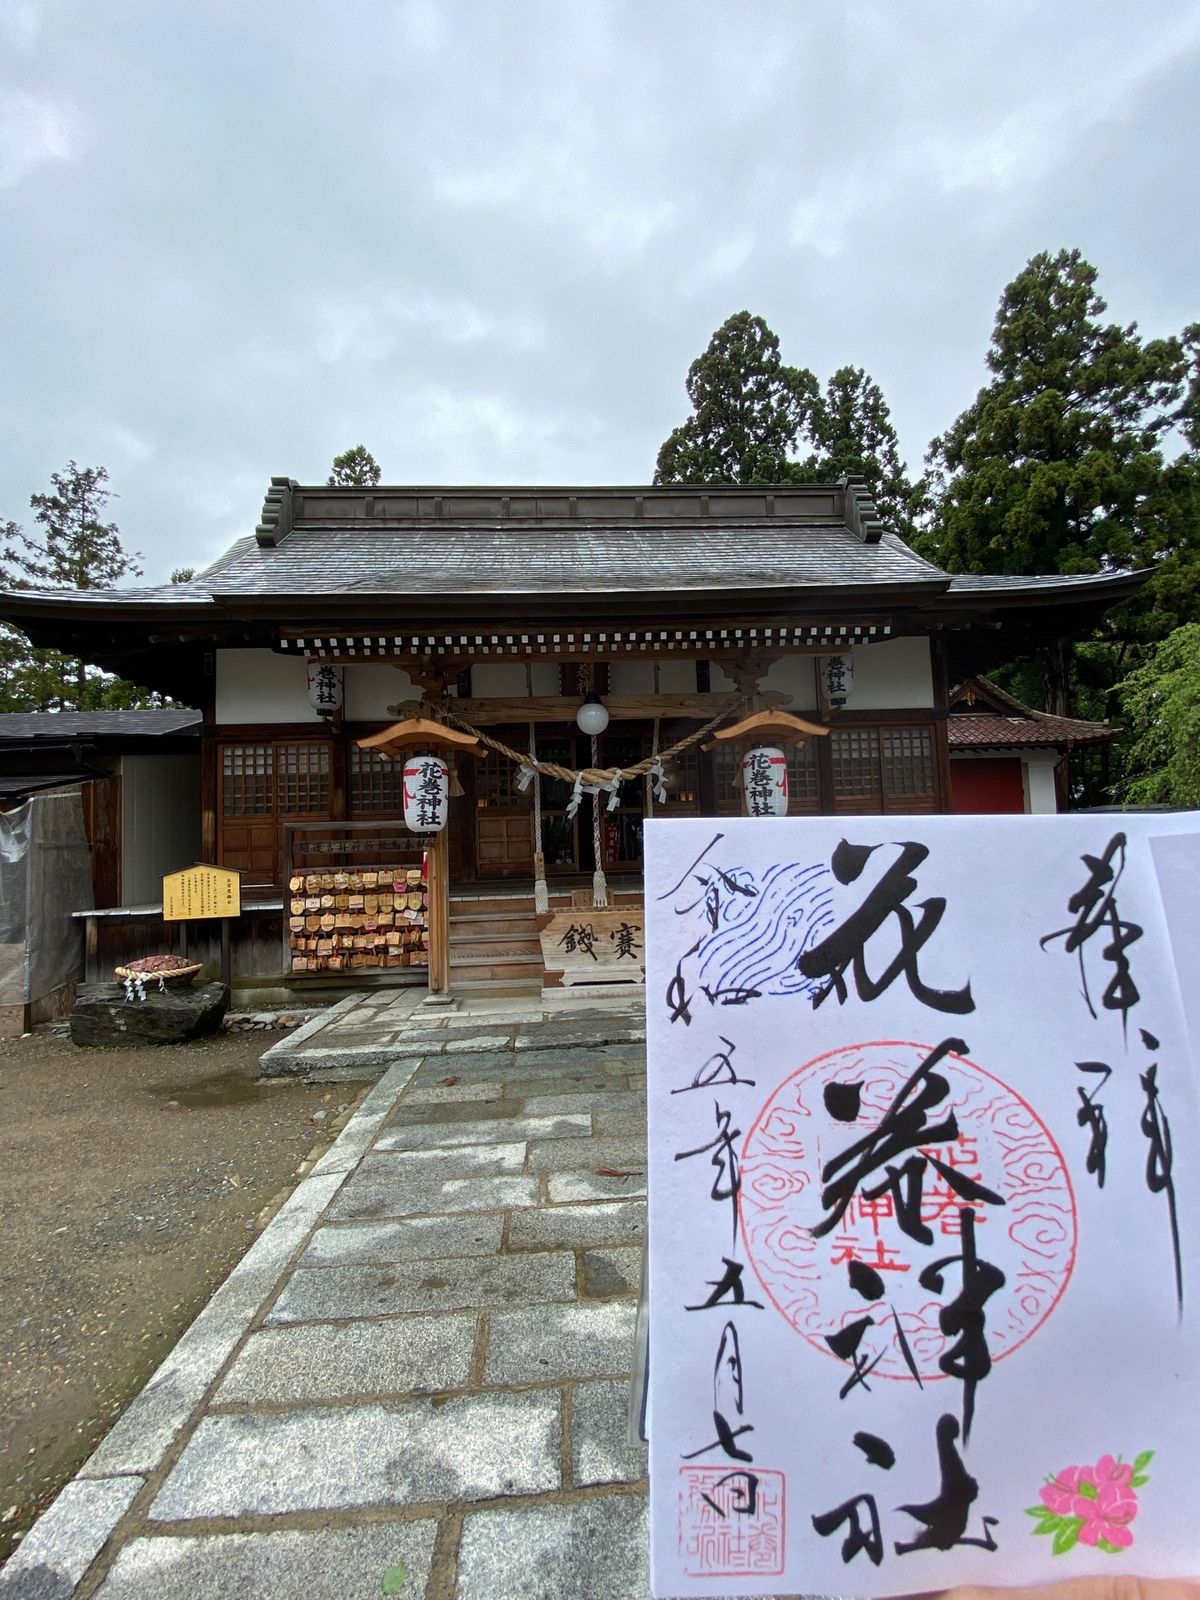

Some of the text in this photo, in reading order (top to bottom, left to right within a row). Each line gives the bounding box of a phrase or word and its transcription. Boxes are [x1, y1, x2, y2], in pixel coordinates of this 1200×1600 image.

[416, 761, 443, 827] 花巻神社
[748, 752, 776, 817] 花巻神社
